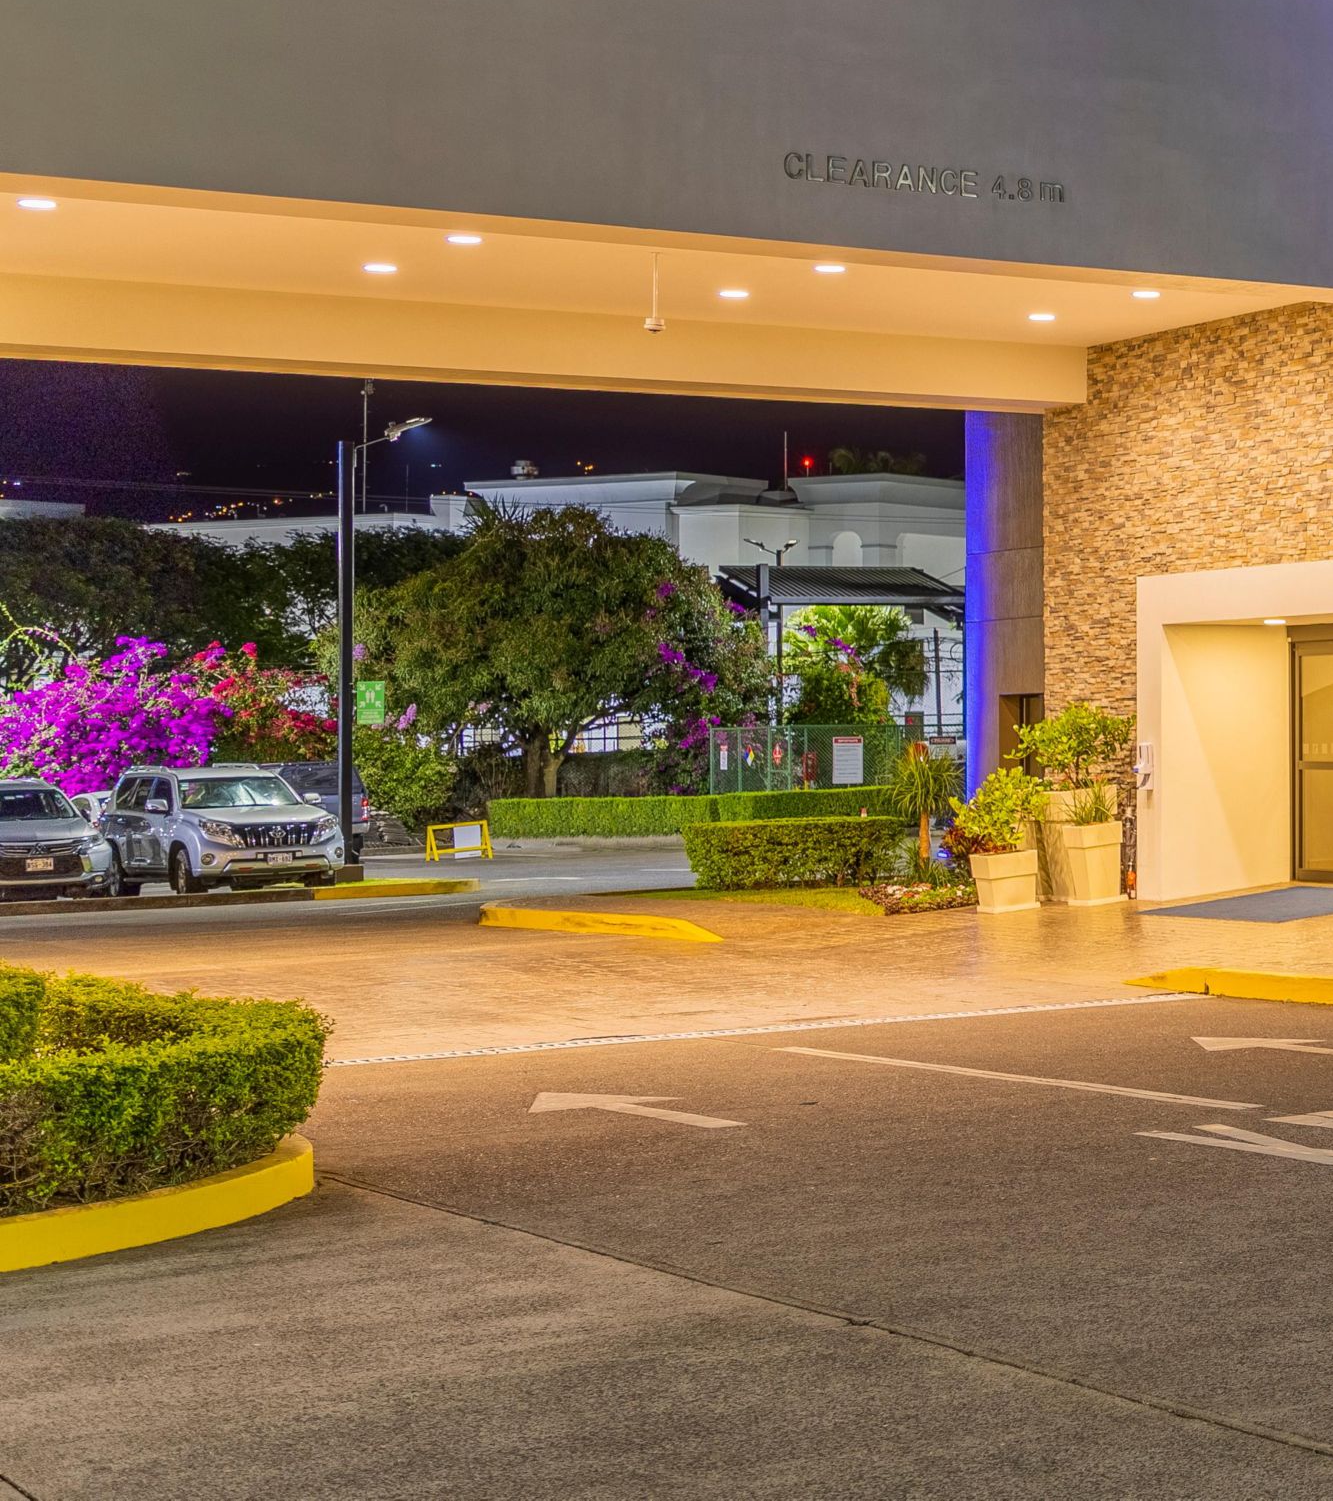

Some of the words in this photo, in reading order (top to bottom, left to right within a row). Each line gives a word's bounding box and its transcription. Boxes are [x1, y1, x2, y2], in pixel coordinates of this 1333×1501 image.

[783, 151, 978, 199] CLEARANCE
[991, 174, 1033, 202] 4.8
[1039, 180, 1065, 203] m
